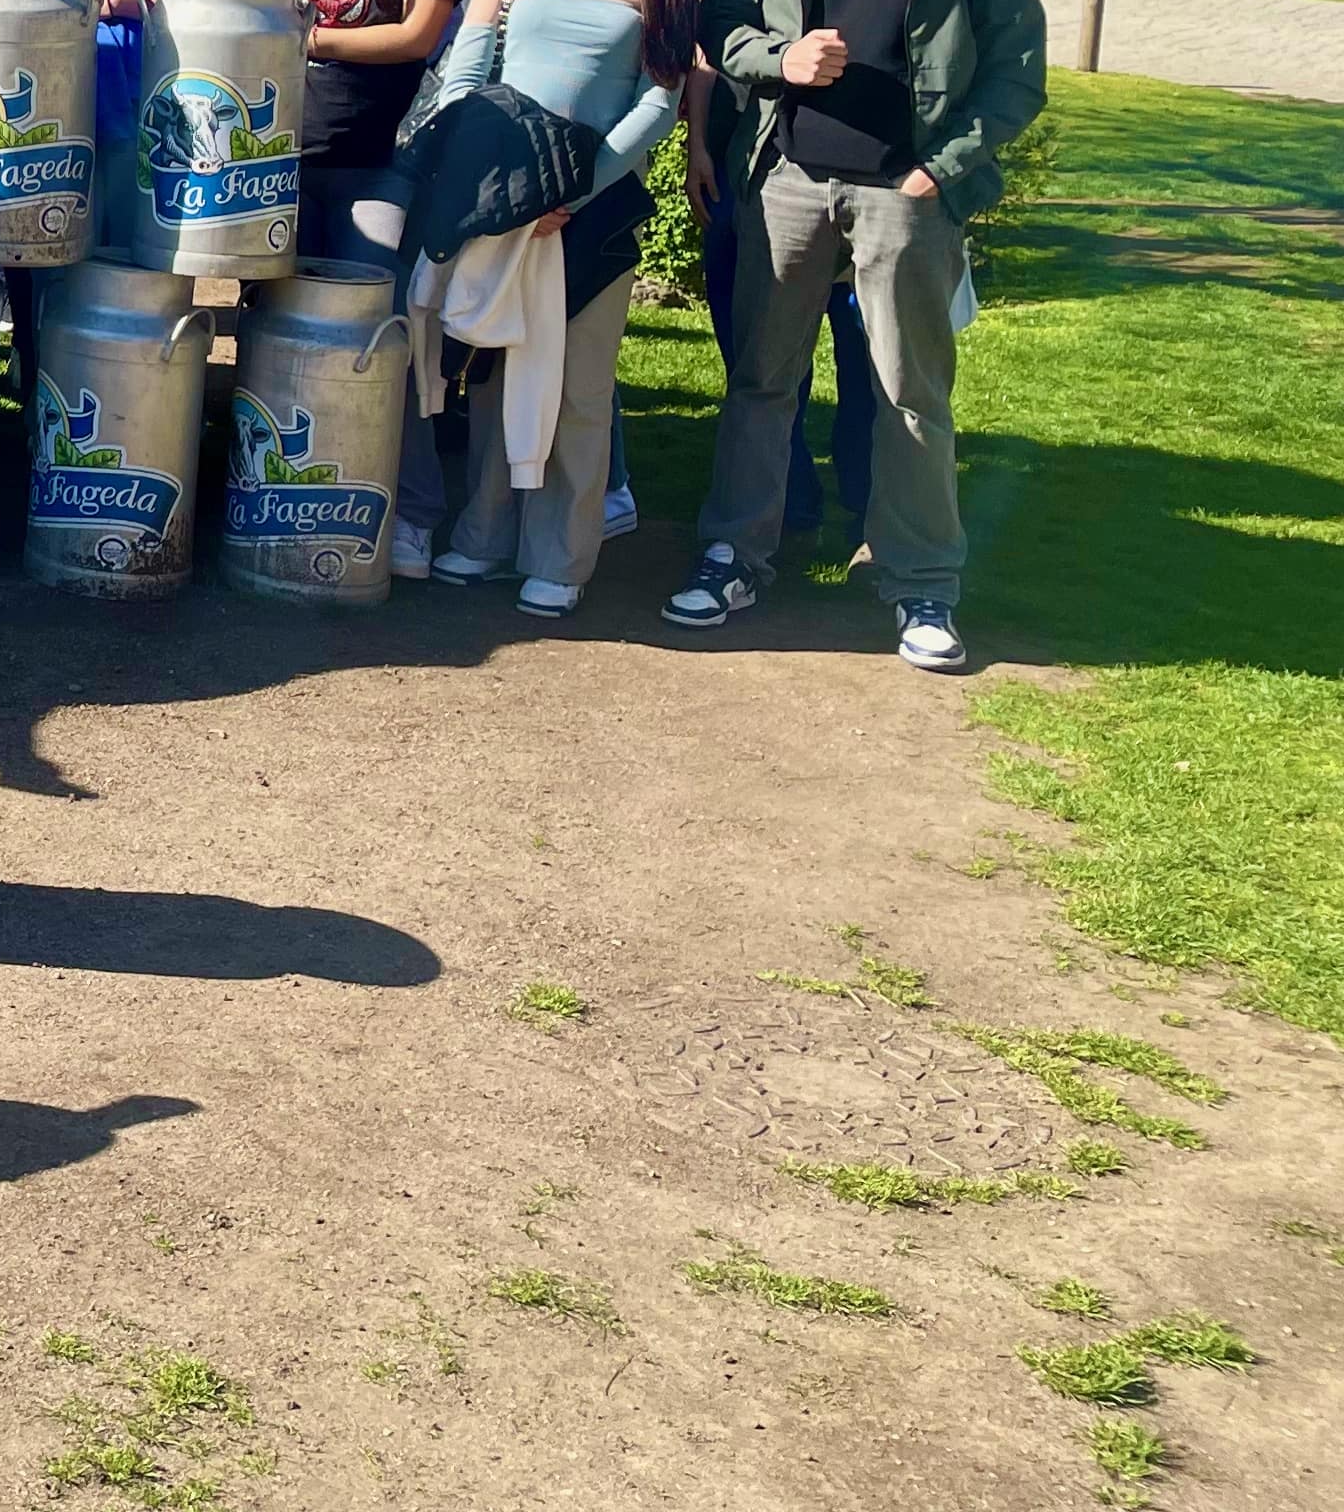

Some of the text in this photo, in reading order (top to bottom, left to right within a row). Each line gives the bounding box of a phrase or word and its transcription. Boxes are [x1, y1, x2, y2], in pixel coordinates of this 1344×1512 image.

[165, 161, 300, 215] La Faged
[44, 472, 158, 515] Fageda
[227, 490, 372, 532] La Fageda
